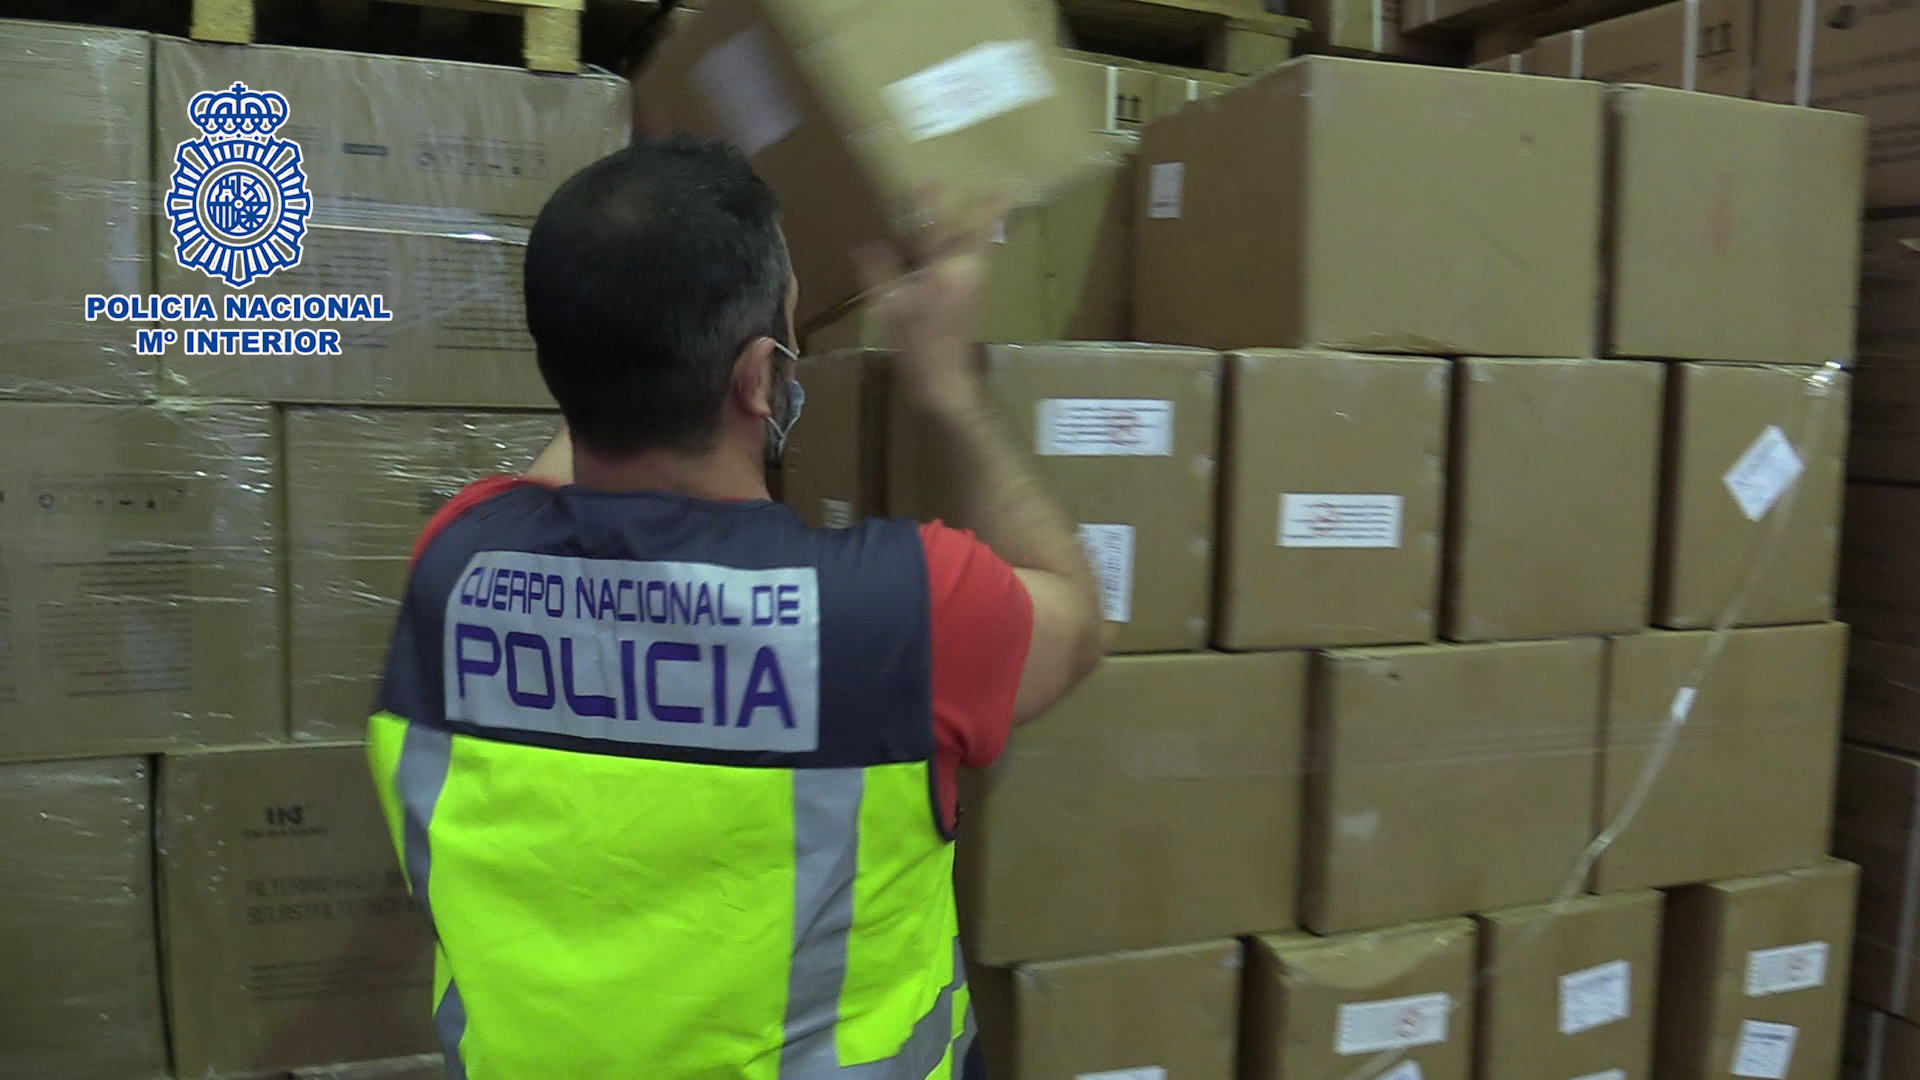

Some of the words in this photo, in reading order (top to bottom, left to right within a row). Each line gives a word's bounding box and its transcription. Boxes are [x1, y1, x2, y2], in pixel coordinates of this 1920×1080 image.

[460, 567, 564, 617] CUERPO
[576, 577, 741, 626] NACIONAL
[752, 585, 799, 626] DE
[456, 623, 796, 729] POLICIA
